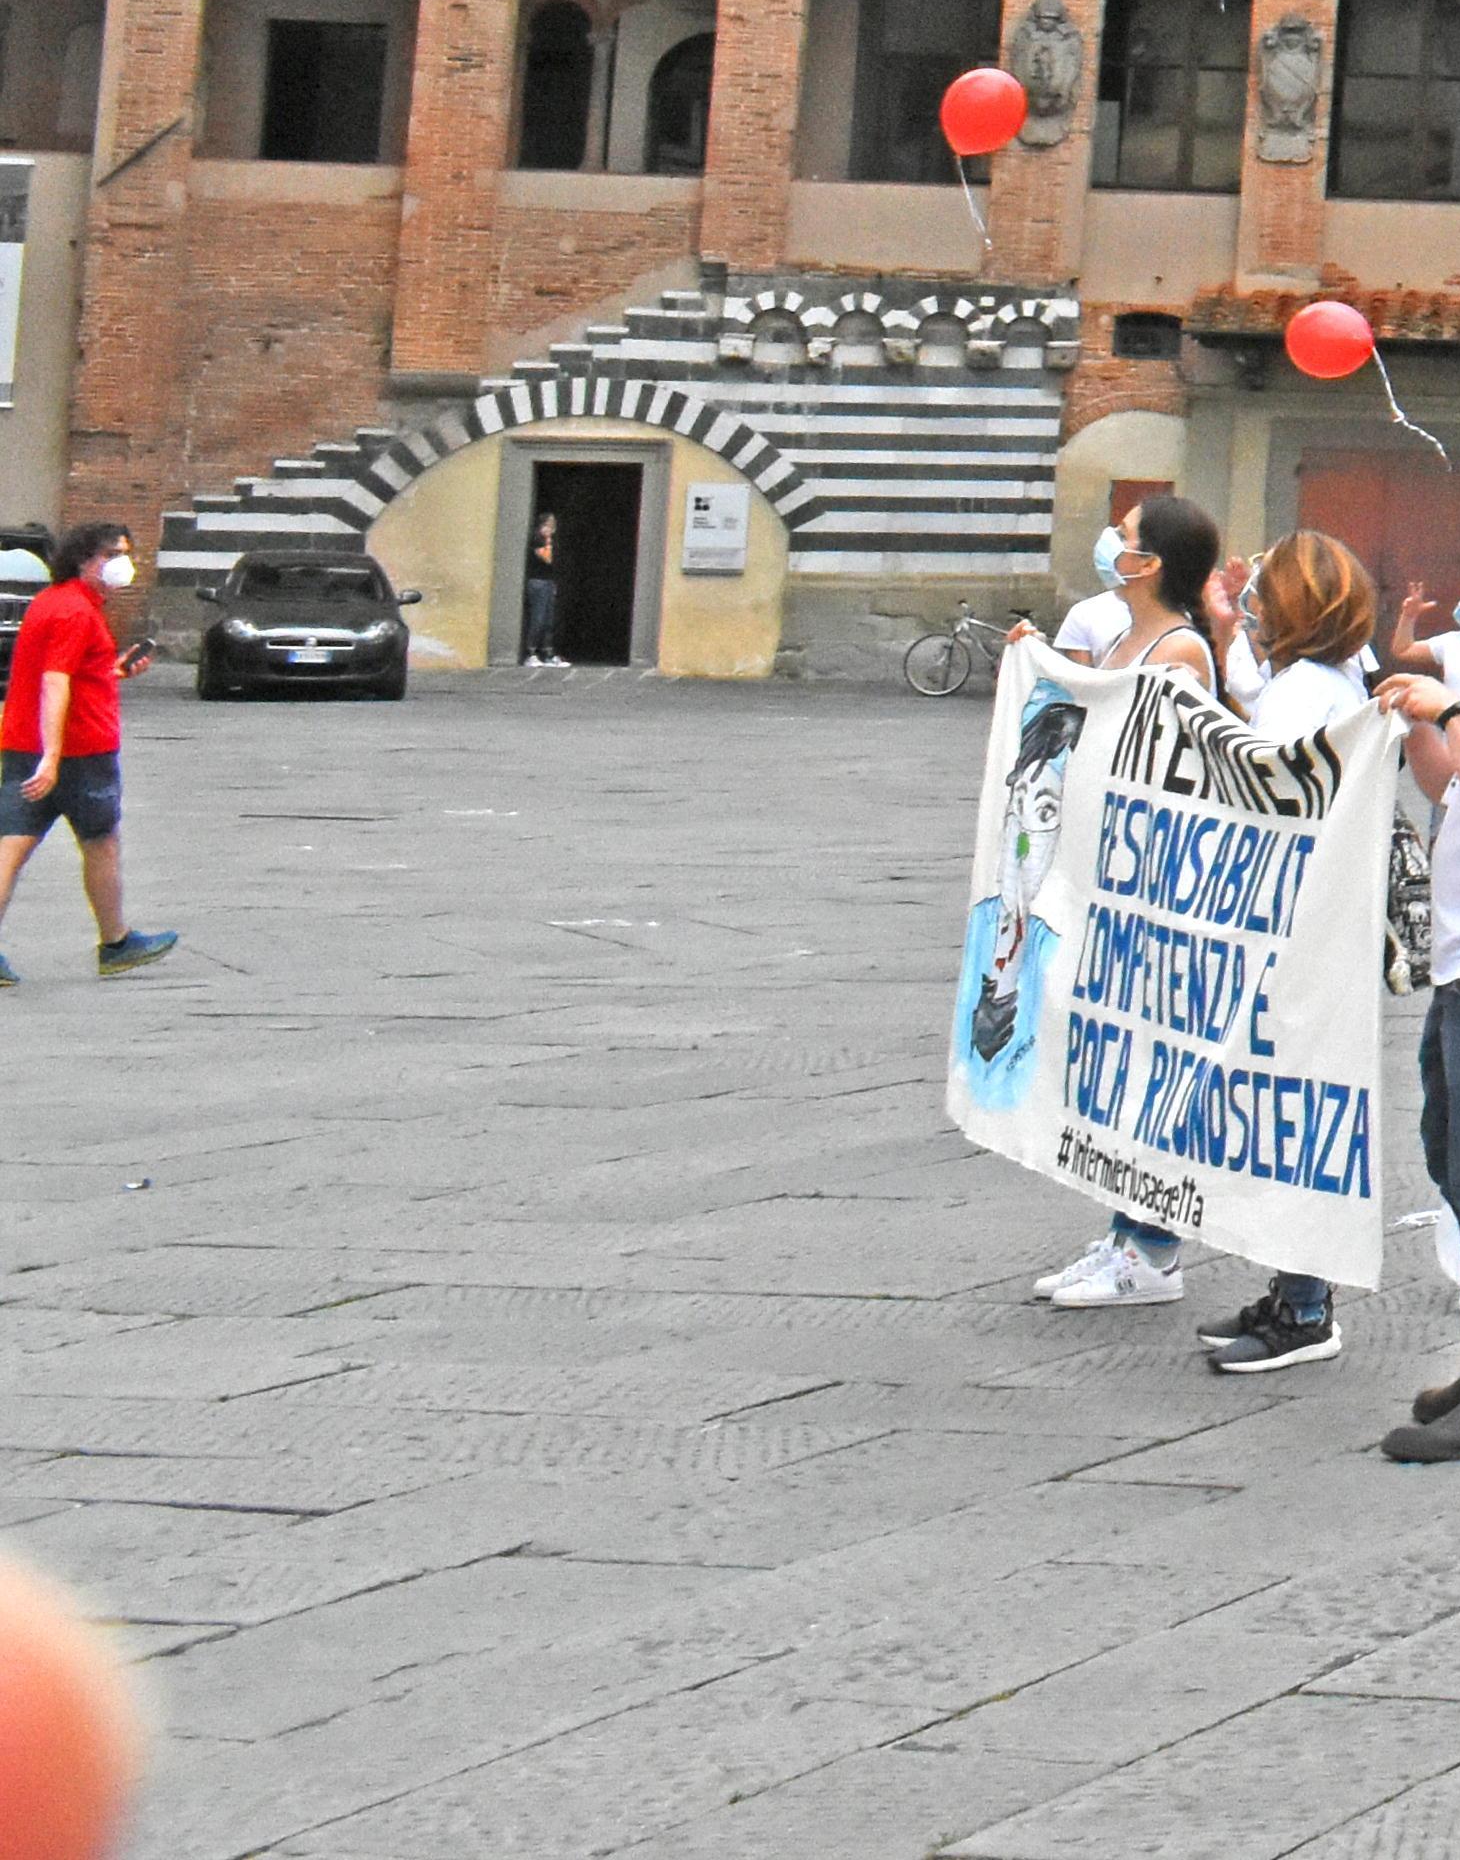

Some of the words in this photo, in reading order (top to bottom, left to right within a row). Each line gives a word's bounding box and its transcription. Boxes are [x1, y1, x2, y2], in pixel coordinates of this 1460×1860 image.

[1072, 902, 1246, 1045] COMPETENZA
[1057, 1125, 1205, 1228] #infermieriusaegetta
[1063, 1011, 1133, 1131] POCA
[1132, 1039, 1371, 1199] RICONOSCENZA
